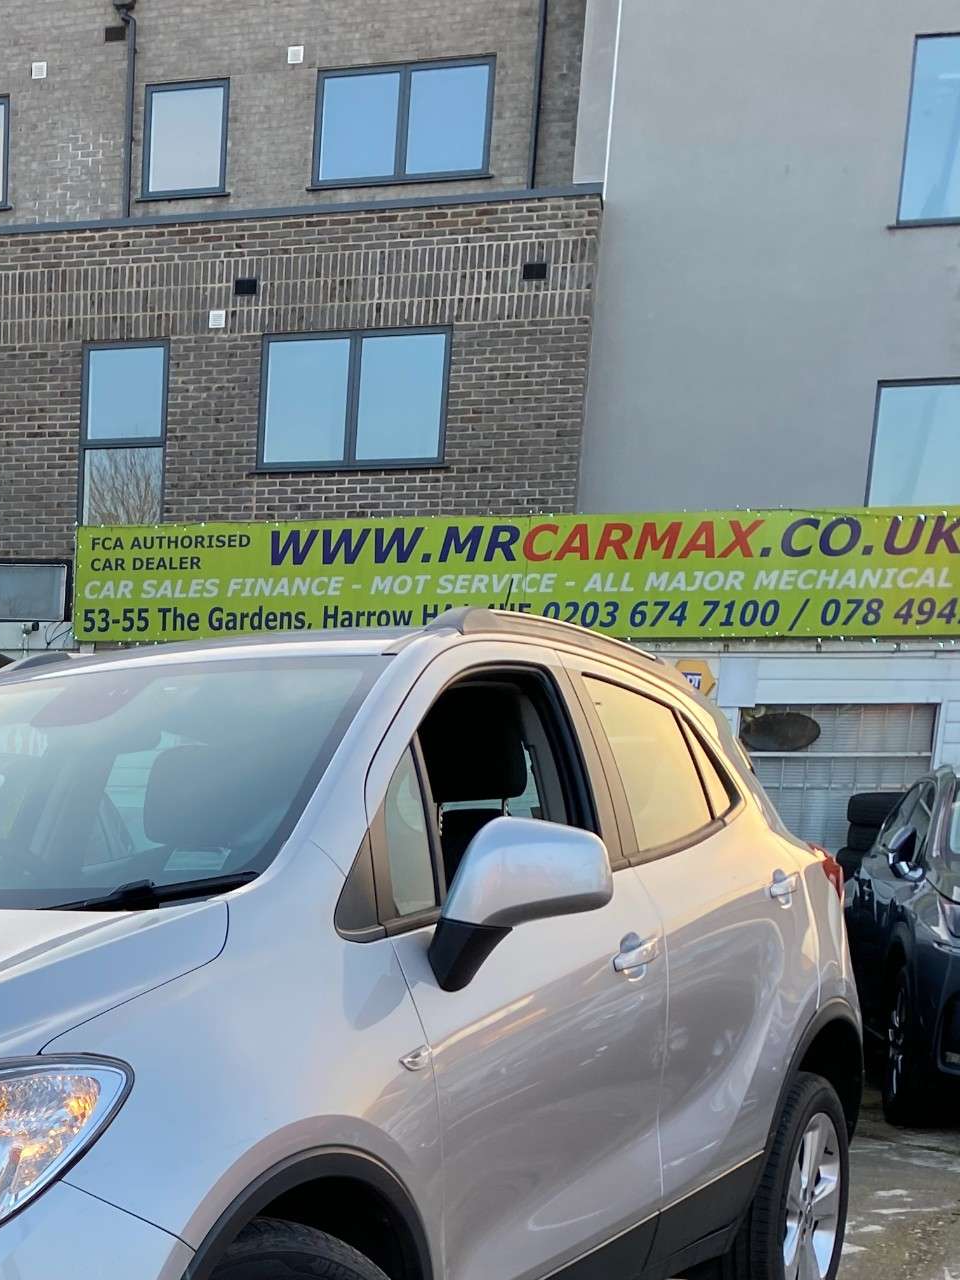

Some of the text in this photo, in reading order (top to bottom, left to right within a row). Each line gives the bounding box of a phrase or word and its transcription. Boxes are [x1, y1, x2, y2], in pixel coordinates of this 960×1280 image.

[91, 534, 251, 551] FCA AUTHORISED
[269, 515, 960, 567] WWW.MRCARMAX.CO.UK
[90, 556, 202, 572] CAR DEALER
[83, 580, 137, 600] CAR
[140, 578, 220, 599] SALES
[227, 576, 344, 597] FINANCE
[370, 574, 431, 595] MOT
[436, 571, 557, 594] SERVICE
[584, 573, 635, 592] ALL
[644, 569, 745, 591] MAJOR
[752, 567, 953, 590] MECHANICAL
[82, 607, 150, 633] 53-55
[157, 608, 200, 632] The
[322, 604, 413, 629] Harrow
[543, 601, 620, 627] 0203
[628, 601, 688, 627] 674
[697, 600, 780, 627] 7100
[820, 598, 883, 625] 078
[893, 597, 960, 625] 494
